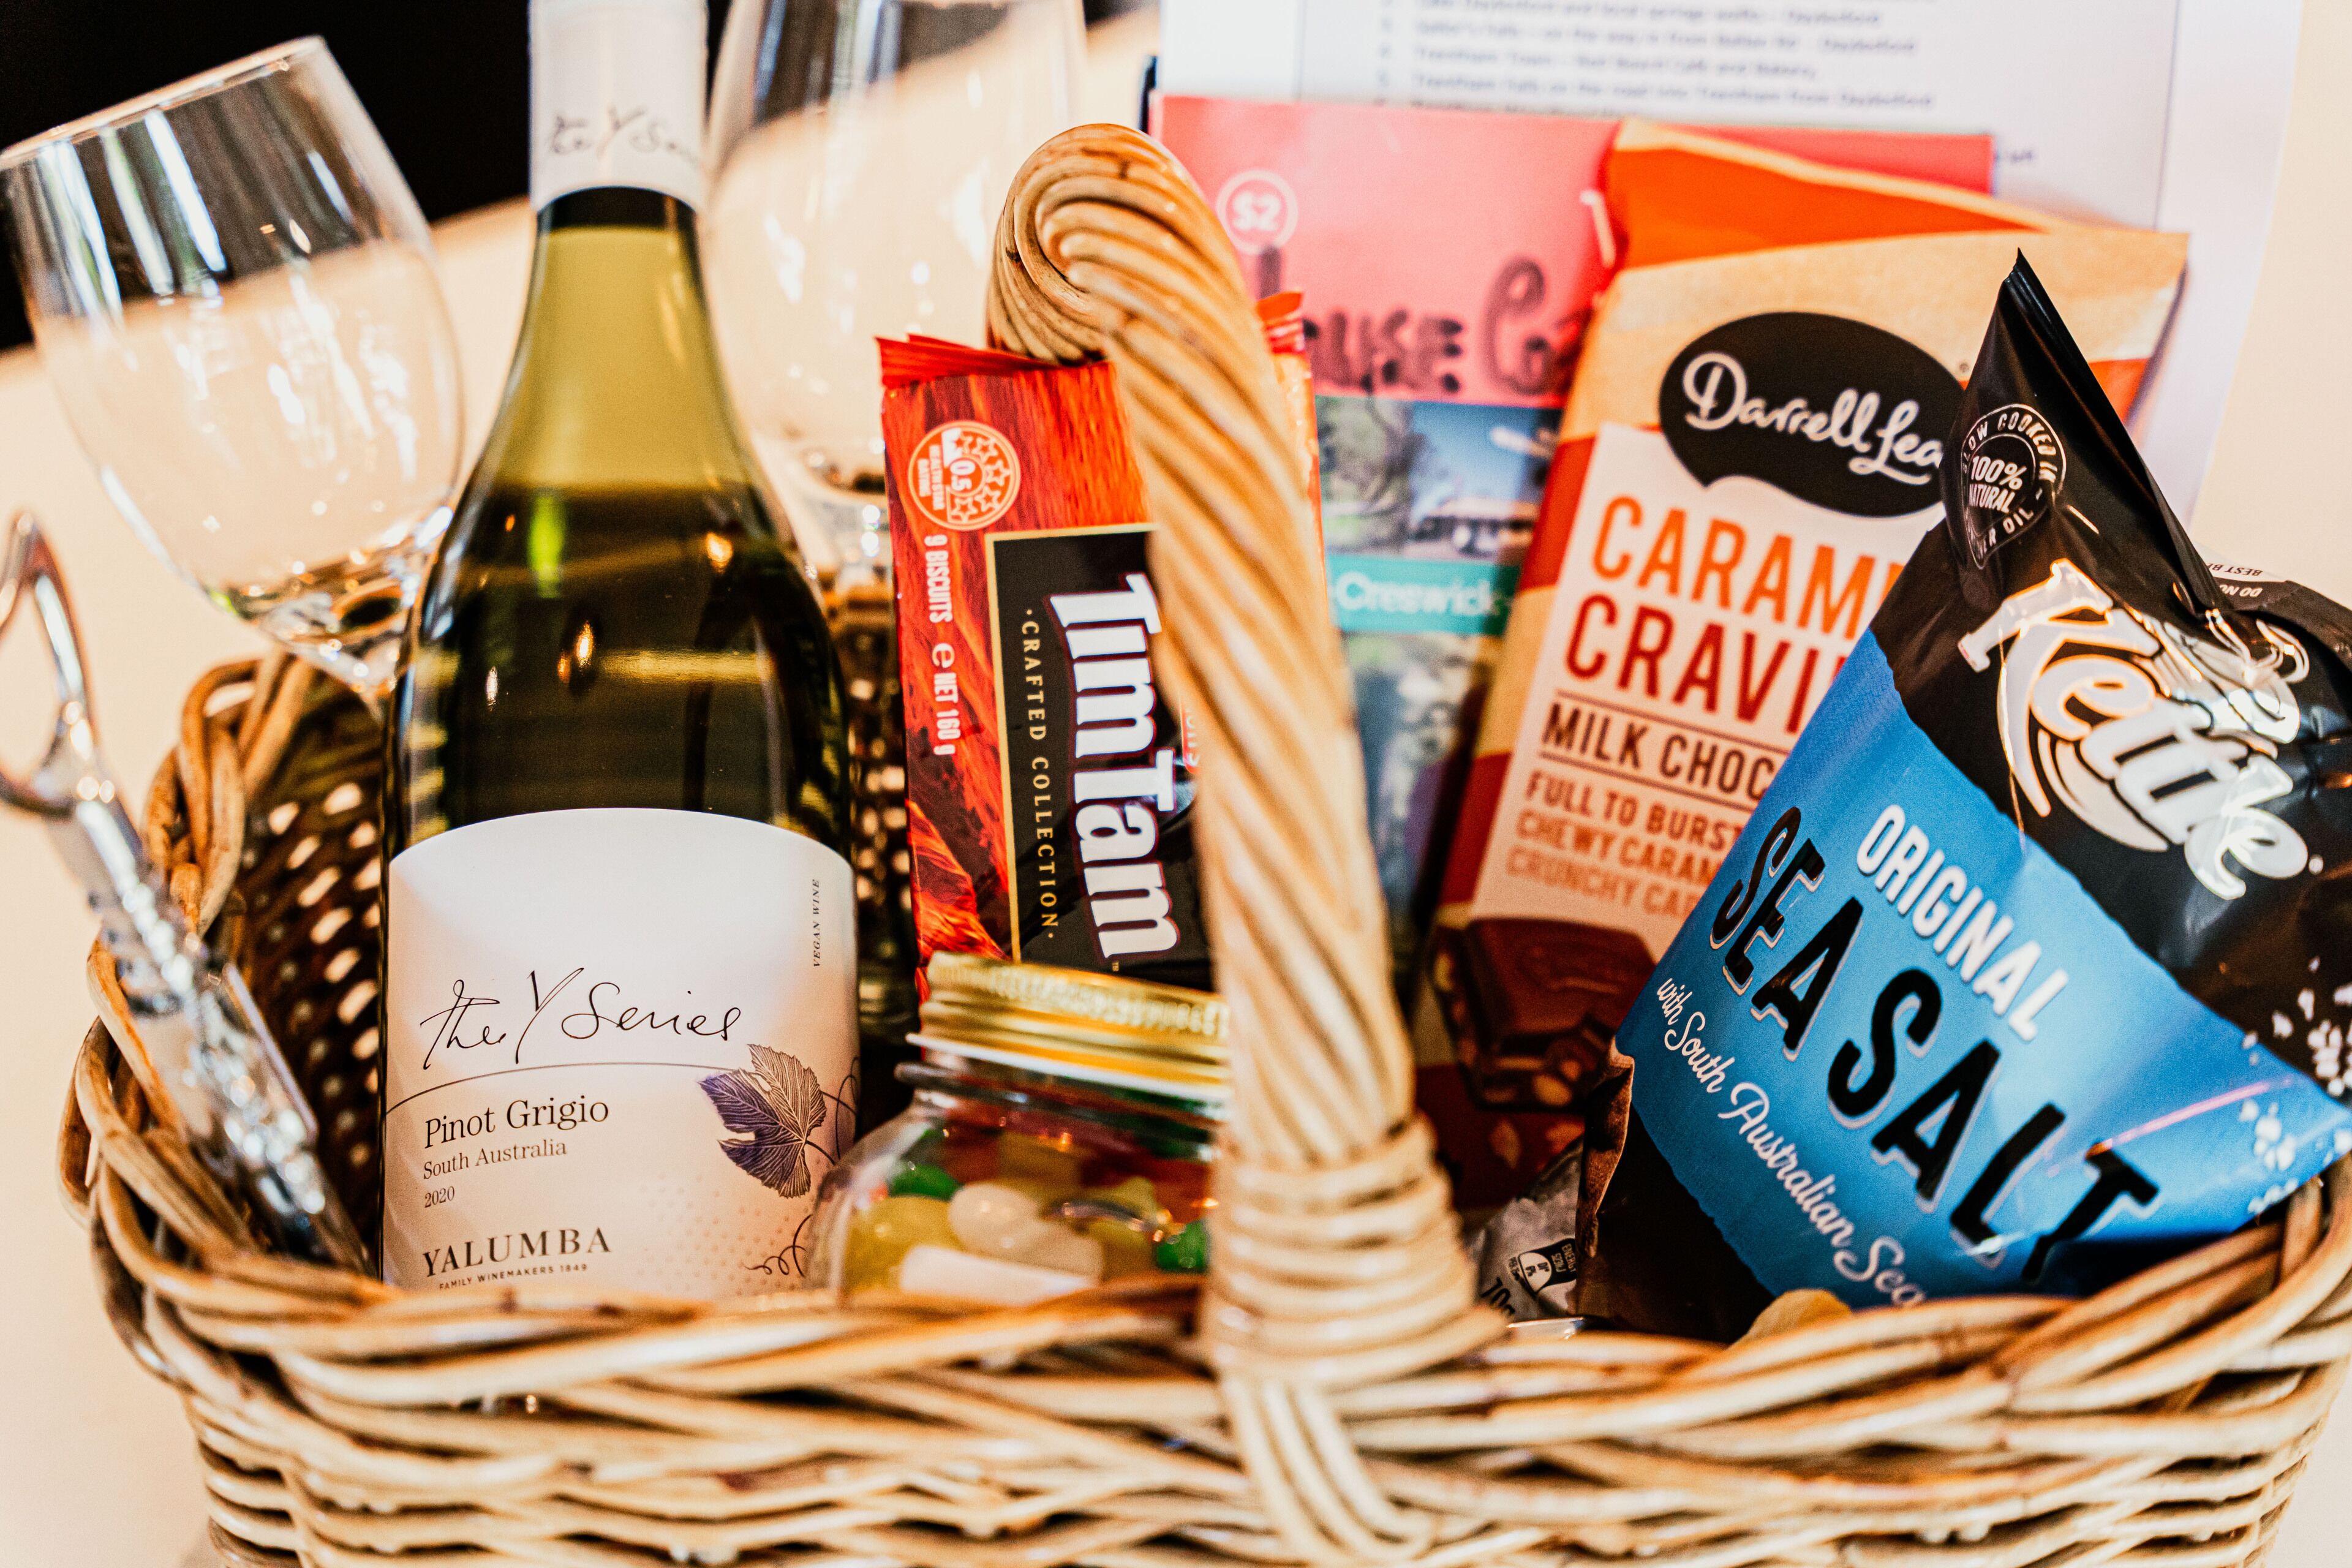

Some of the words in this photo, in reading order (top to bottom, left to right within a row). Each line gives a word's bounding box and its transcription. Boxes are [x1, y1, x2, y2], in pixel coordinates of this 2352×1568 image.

[1683, 351, 1872, 454] Darrell
[1849, 400, 1942, 486] Lea
[1997, 411, 2057, 456] COOKED
[1970, 456, 2027, 491] 100%
[924, 533, 948, 547] 9
[2002, 507, 2034, 535] OIL
[925, 550, 953, 624] BISCUITS
[1591, 495, 1907, 642] CARAM
[2224, 566, 2264, 576] BEST
[2239, 587, 2263, 598] DO
[933, 672, 959, 703] NET
[1022, 620, 1047, 741] CRAFTED
[1564, 593, 1848, 736] CRAVI
[936, 709, 962, 741] 160
[1542, 702, 1643, 770] MILK
[1958, 558, 2309, 900] Kettle
[1525, 769, 1594, 818] FULL
[1604, 790, 1640, 827] TO
[1031, 756, 1060, 929] COLLECTION
[812, 878, 820, 915] WINE
[1856, 804, 2068, 1041] ORIGINAL
[813, 921, 821, 968] VEGAN
[420, 979, 507, 1071] the
[514, 967, 585, 1065] Y
[561, 981, 742, 1041] Series
[1656, 977, 1694, 1027] with
[1664, 1011, 1735, 1095] South
[1710, 805, 1865, 1062] SEA
[1827, 967, 2161, 1285] SALT
[424, 1106, 496, 1149] Pinot
[506, 1095, 609, 1131] Grigio
[423, 1152, 470, 1180] South
[475, 1139, 568, 1167] Australia
[1718, 1081, 1855, 1262] Australian
[424, 1186, 456, 1208] 2020
[423, 1227, 611, 1278] YALUMBA
[439, 1276, 473, 1291] FAMILY
[477, 1265, 554, 1283] WINEMAKERS
[559, 1263, 589, 1273] 1849
[1834, 1236, 1928, 1306] Sea
